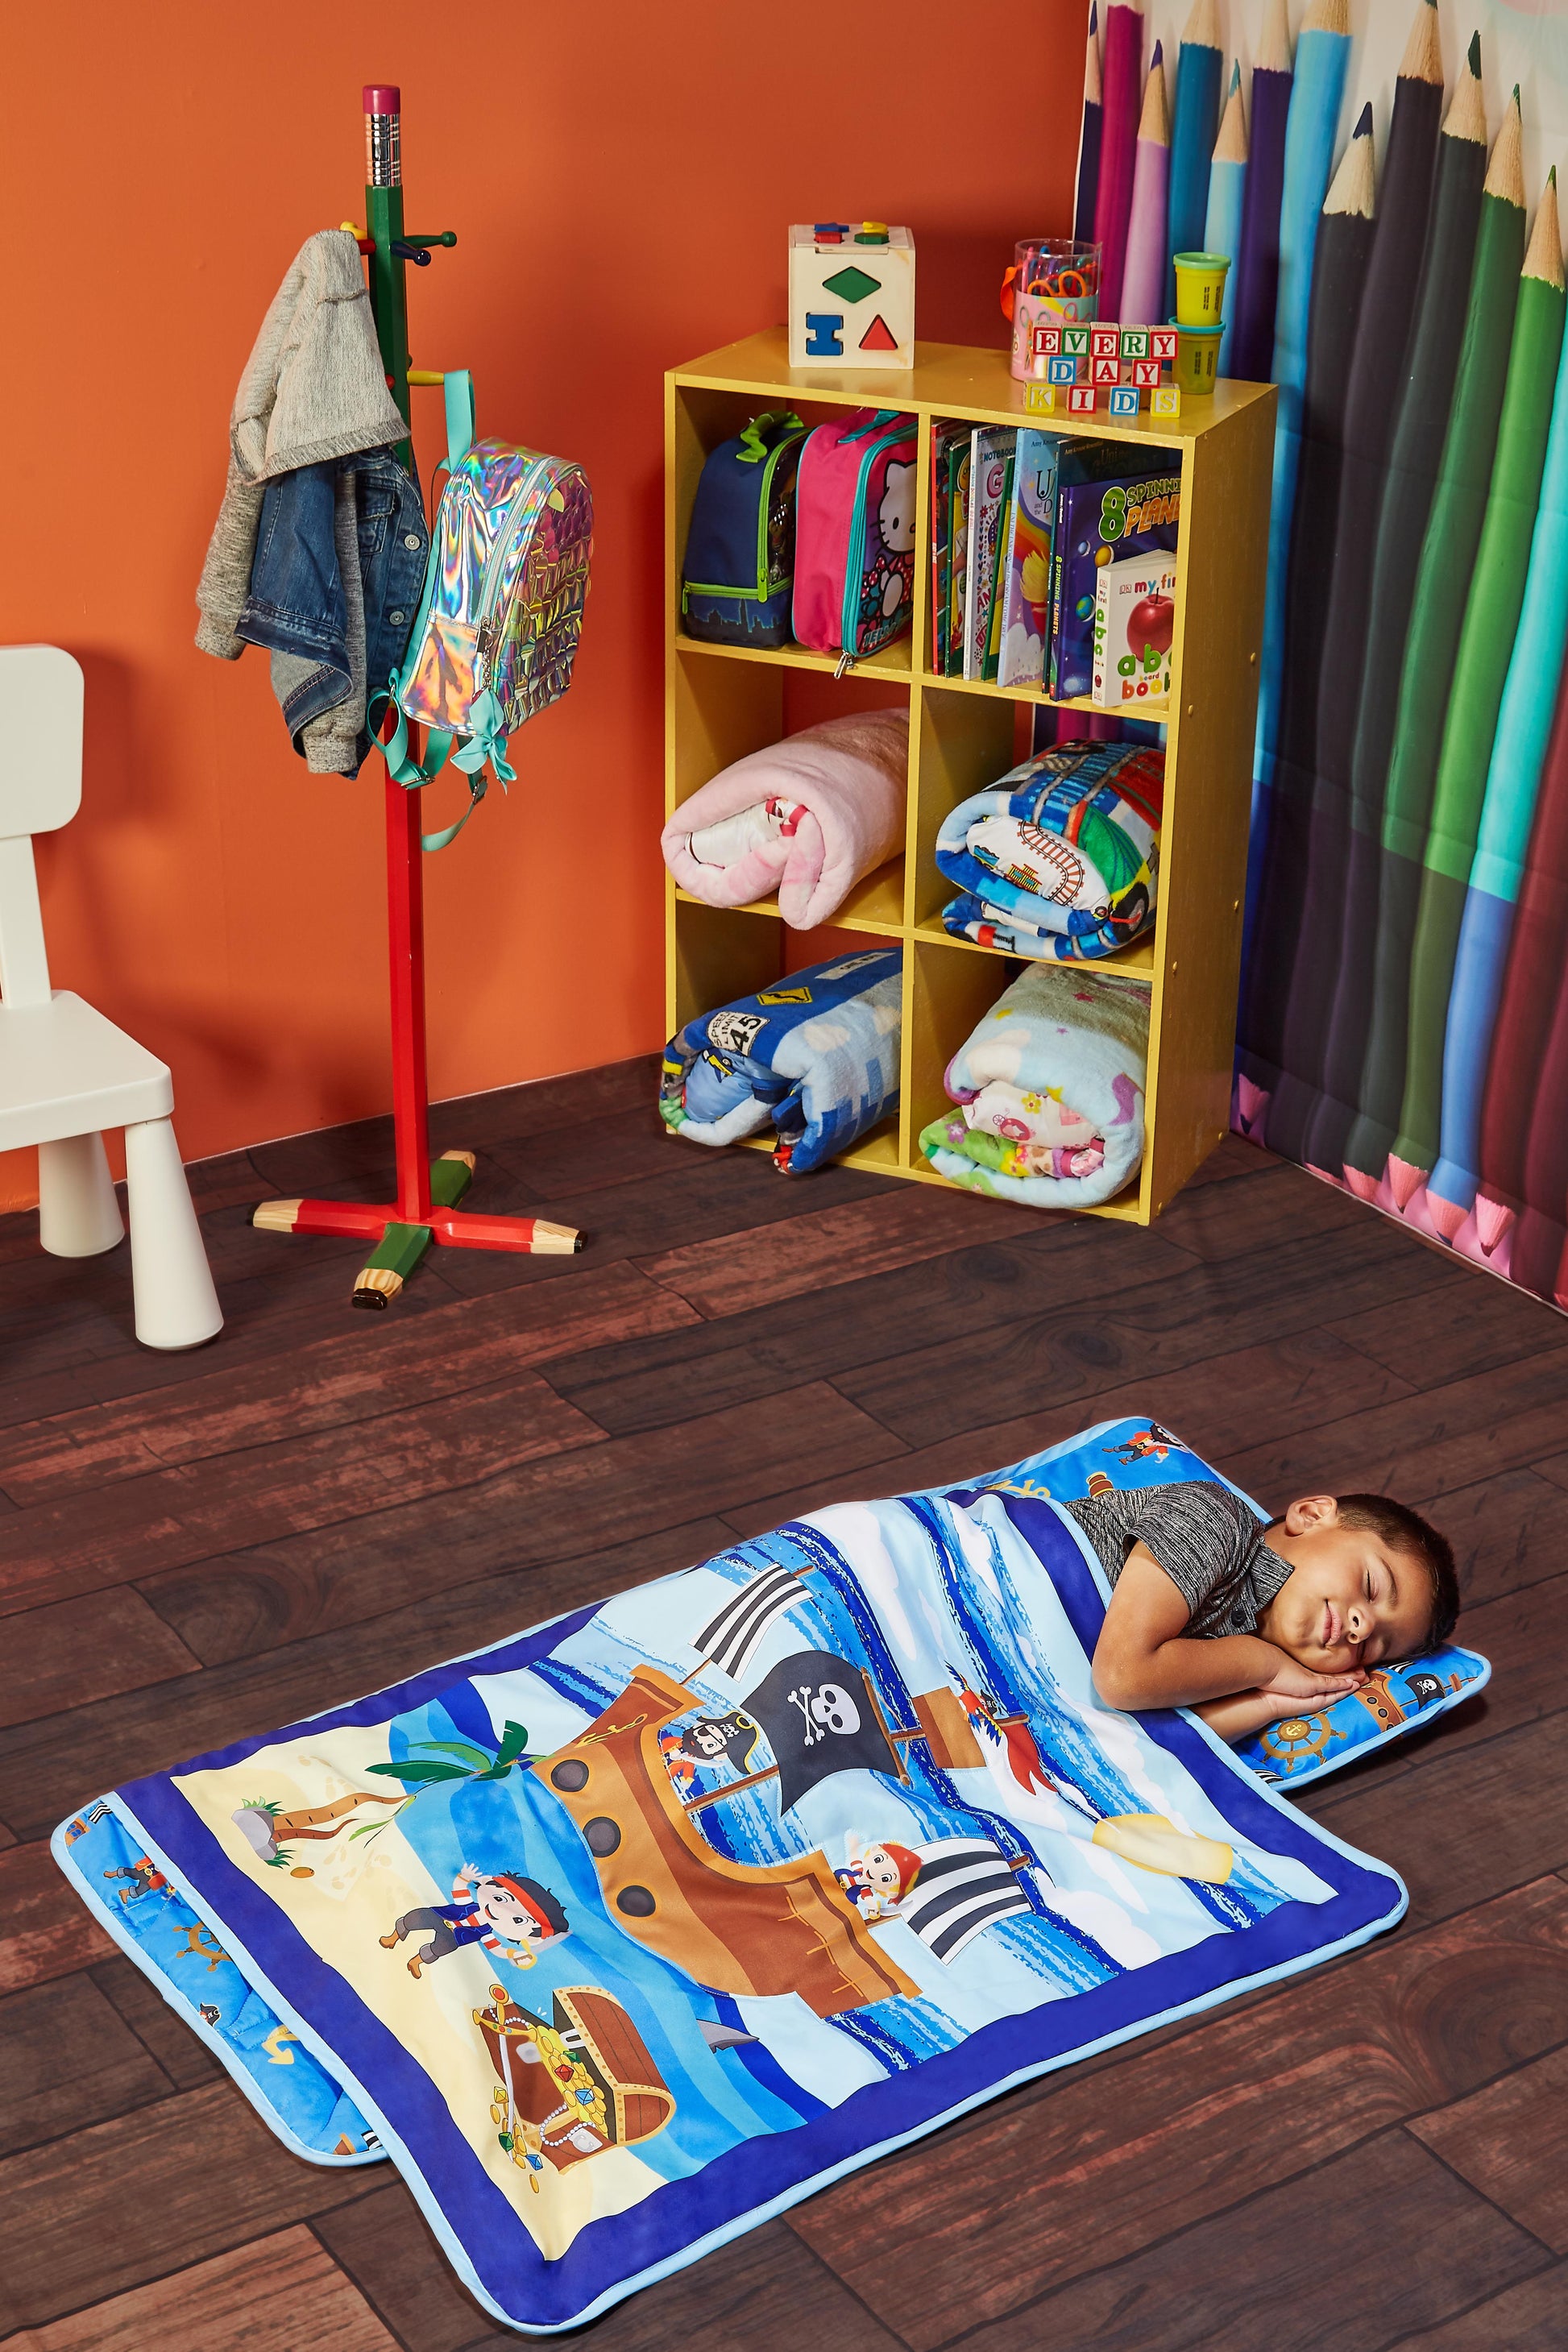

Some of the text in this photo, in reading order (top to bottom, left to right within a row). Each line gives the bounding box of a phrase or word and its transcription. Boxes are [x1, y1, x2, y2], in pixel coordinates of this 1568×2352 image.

[1039, 332, 1172, 355] EVERY
[1054, 362, 1155, 383] DAY
[1031, 388, 1175, 412] KIDS
[1098, 486, 1126, 542] 8
[1126, 478, 1181, 507] SPINNI
[1054, 564, 1062, 600] SPINNING
[1135, 580, 1156, 595] my
[1161, 572, 1176, 589] fir
[1139, 672, 1159, 682] board
[722, 1015, 739, 1044] LIMIT
[730, 1016, 761, 1052] 45
